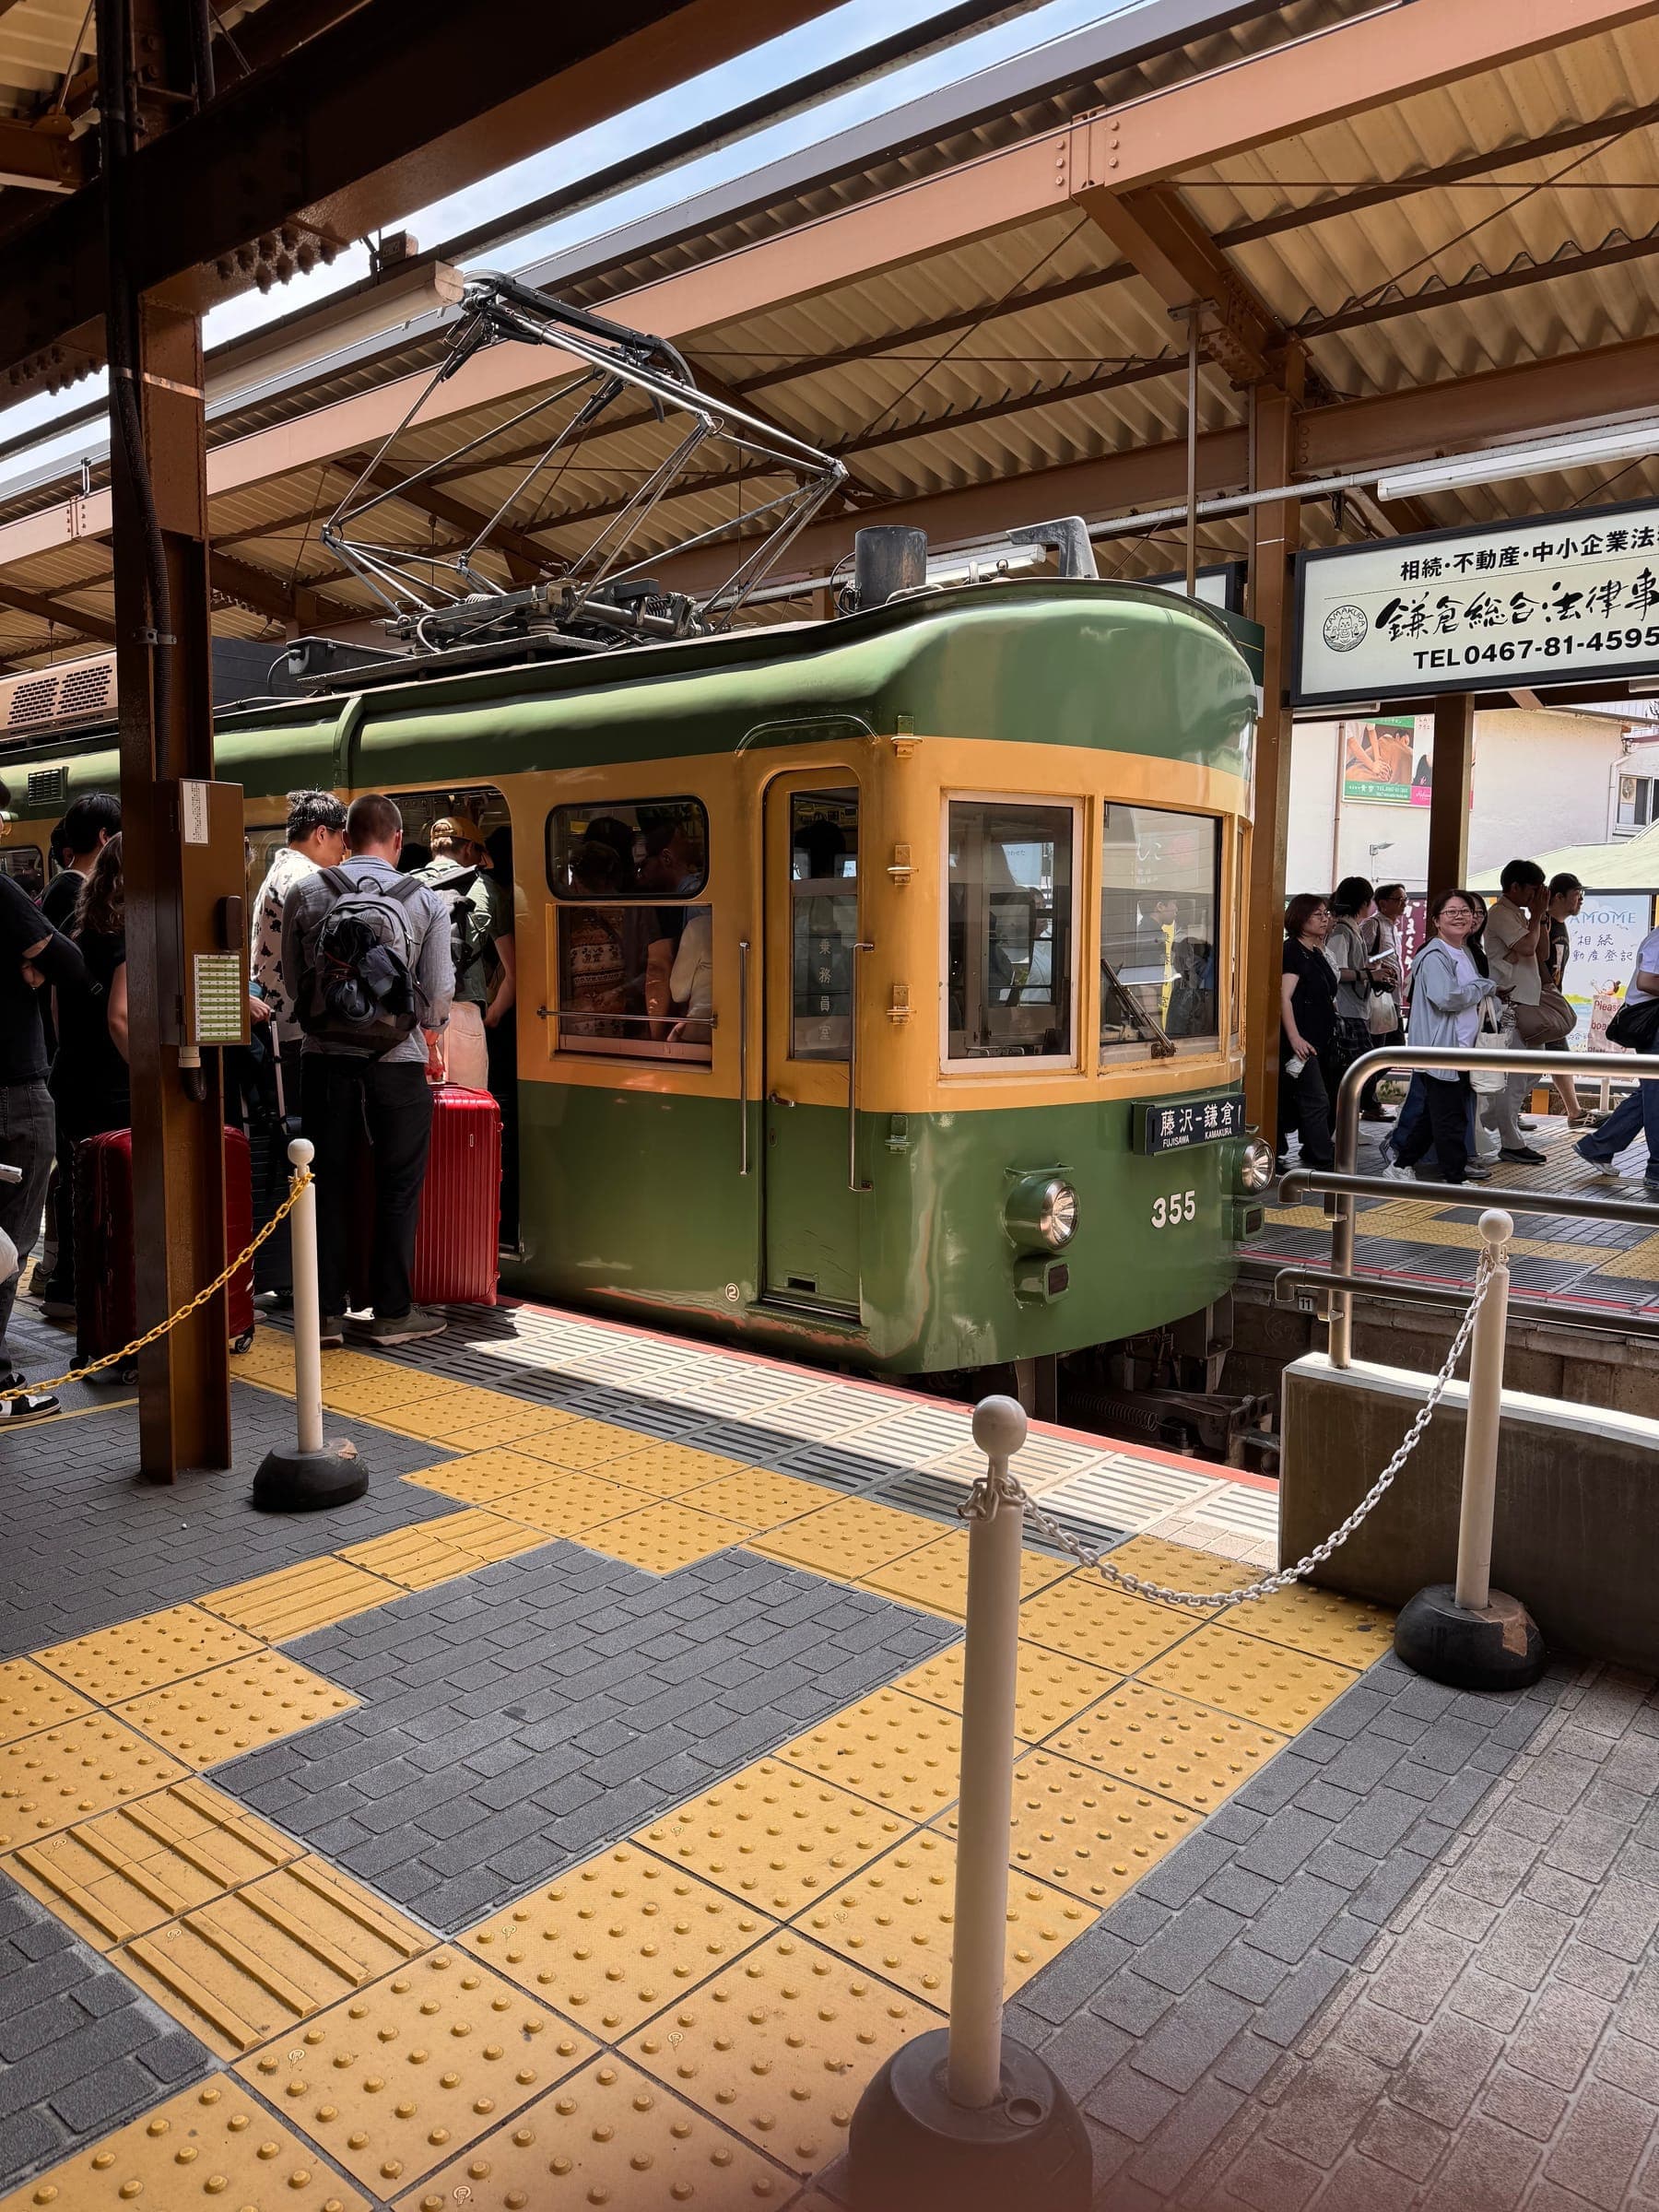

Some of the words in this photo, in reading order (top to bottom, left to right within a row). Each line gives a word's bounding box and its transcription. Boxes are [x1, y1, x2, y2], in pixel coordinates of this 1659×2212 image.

[1400, 526, 1659, 581] 相続・不動産・中小企業法
[1324, 607, 1366, 631] KAMAKURA
[1375, 567, 1659, 641] 鎌倉総合法律事
[1577, 934, 1614, 947] 相続
[818, 938, 832, 1041] 乗務員室
[1162, 1135, 1190, 1149] FUJISAWA
[1204, 1126, 1233, 1141] KAMAKURA
[1151, 1190, 1195, 1229] 355
[1300, 1299, 1311, 1310] 11
